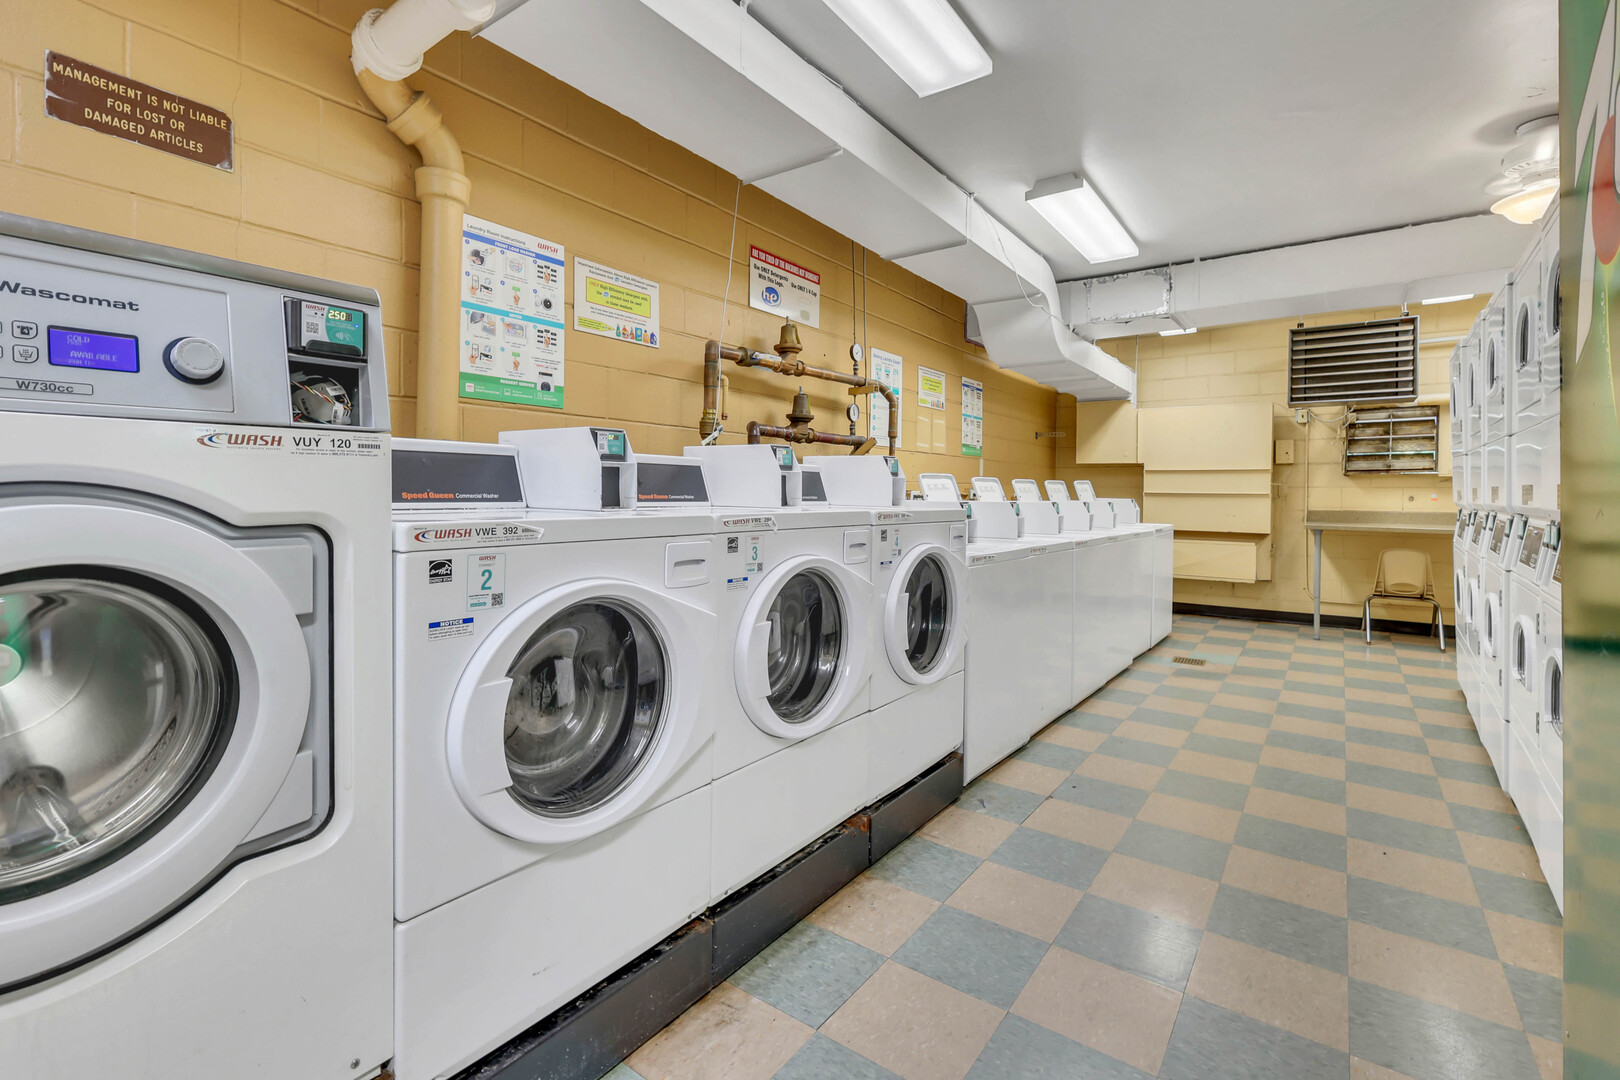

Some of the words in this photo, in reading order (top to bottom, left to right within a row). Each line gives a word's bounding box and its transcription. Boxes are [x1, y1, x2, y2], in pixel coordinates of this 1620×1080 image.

[53, 62, 142, 101] MANAGEMENT
[147, 94, 158, 106] IS
[163, 100, 185, 115] NOT
[190, 109, 227, 130] LIABLE
[107, 98, 131, 115] FOR
[136, 107, 165, 125] LOST
[170, 119, 185, 132] OR
[84, 107, 145, 135] DAMAGED
[150, 129, 203, 153] ARTICLES
[537, 242, 559, 254] WASH
[758, 272, 766, 280] With
[760, 266, 770, 275] ONLY
[0, 281, 140, 312] Wascomat
[305, 303, 326, 312] WASH
[70, 350, 118, 362] AVAILABLE
[16, 380, 75, 394] W730cc
[227, 433, 283, 447] WASH
[292, 436, 322, 448] VUY
[330, 438, 352, 449] 120
[401, 491, 428, 500] Speed
[428, 491, 455, 499] Queen
[434, 528, 473, 540] WASH
[474, 527, 497, 536] VWE
[503, 526, 519, 536] 392
[751, 545, 758, 561] 3
[480, 569, 493, 591] 2
[440, 619, 464, 628] NOTICE
